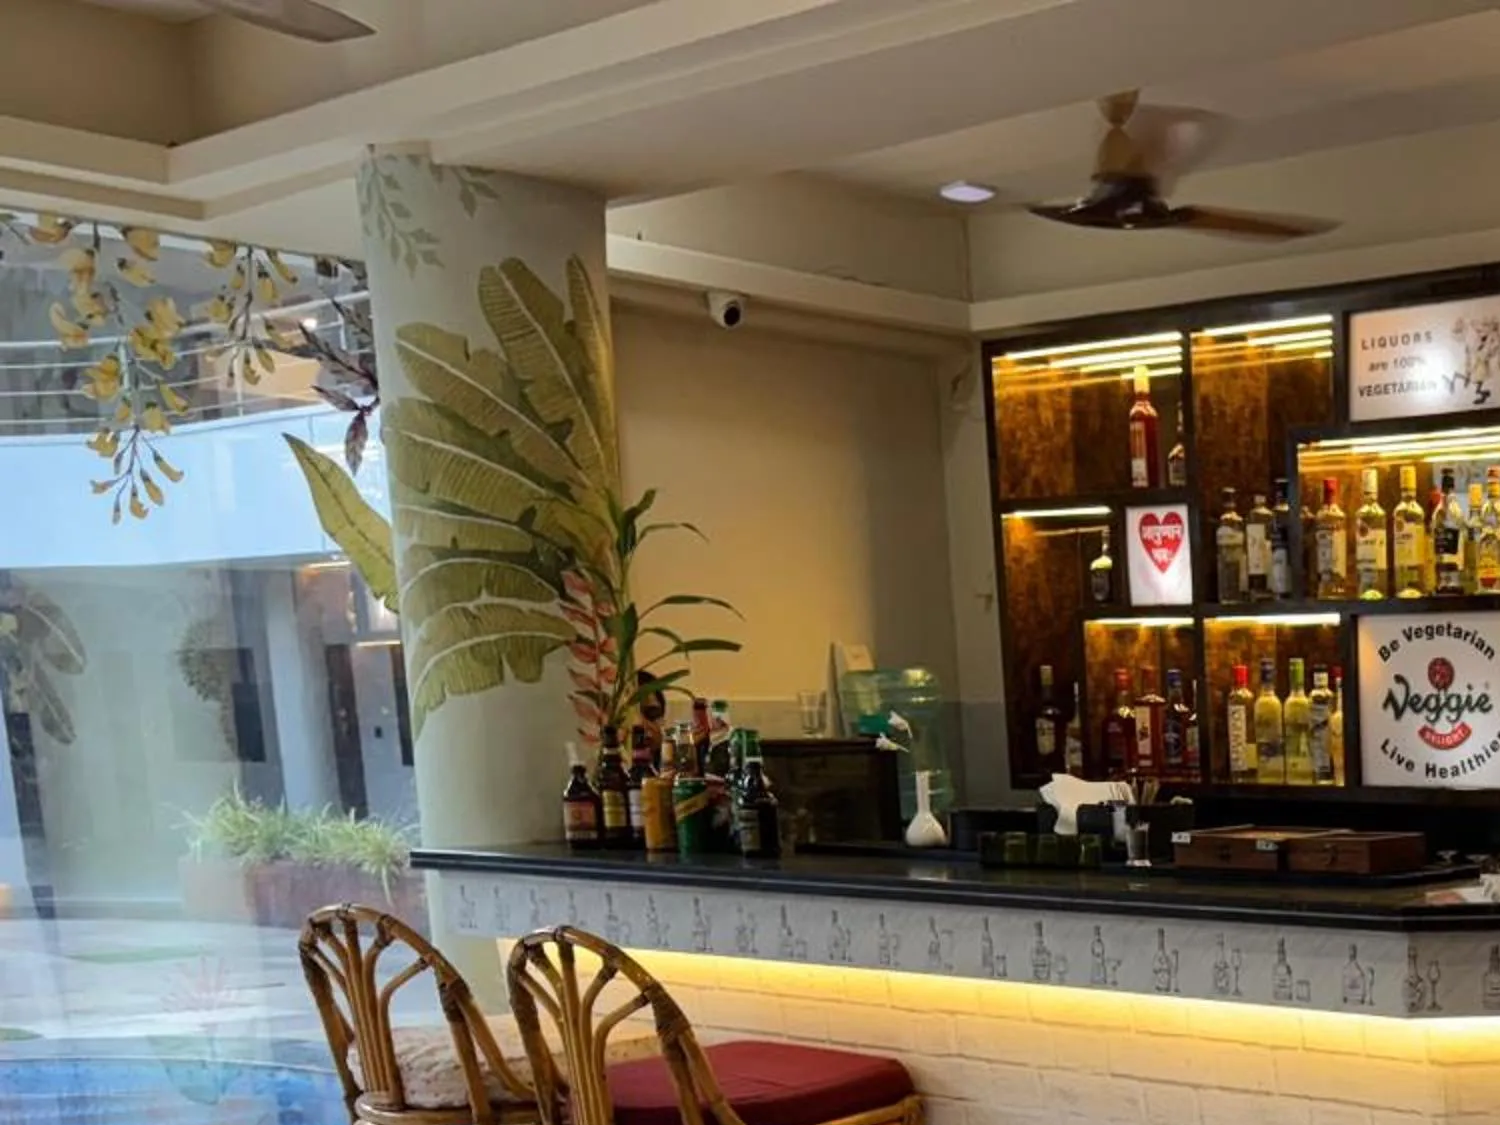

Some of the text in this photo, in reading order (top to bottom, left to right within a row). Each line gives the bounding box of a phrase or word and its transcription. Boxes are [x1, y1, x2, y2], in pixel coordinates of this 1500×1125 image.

[1361, 331, 1432, 351] LIQUORS
[1369, 360, 1389, 371] are
[1358, 380, 1438, 398] VEGETARIAN
[1378, 621, 1496, 663] Be Vegetarian
[1382, 673, 1493, 724] Veggie
[1380, 738, 1415, 772] Live
